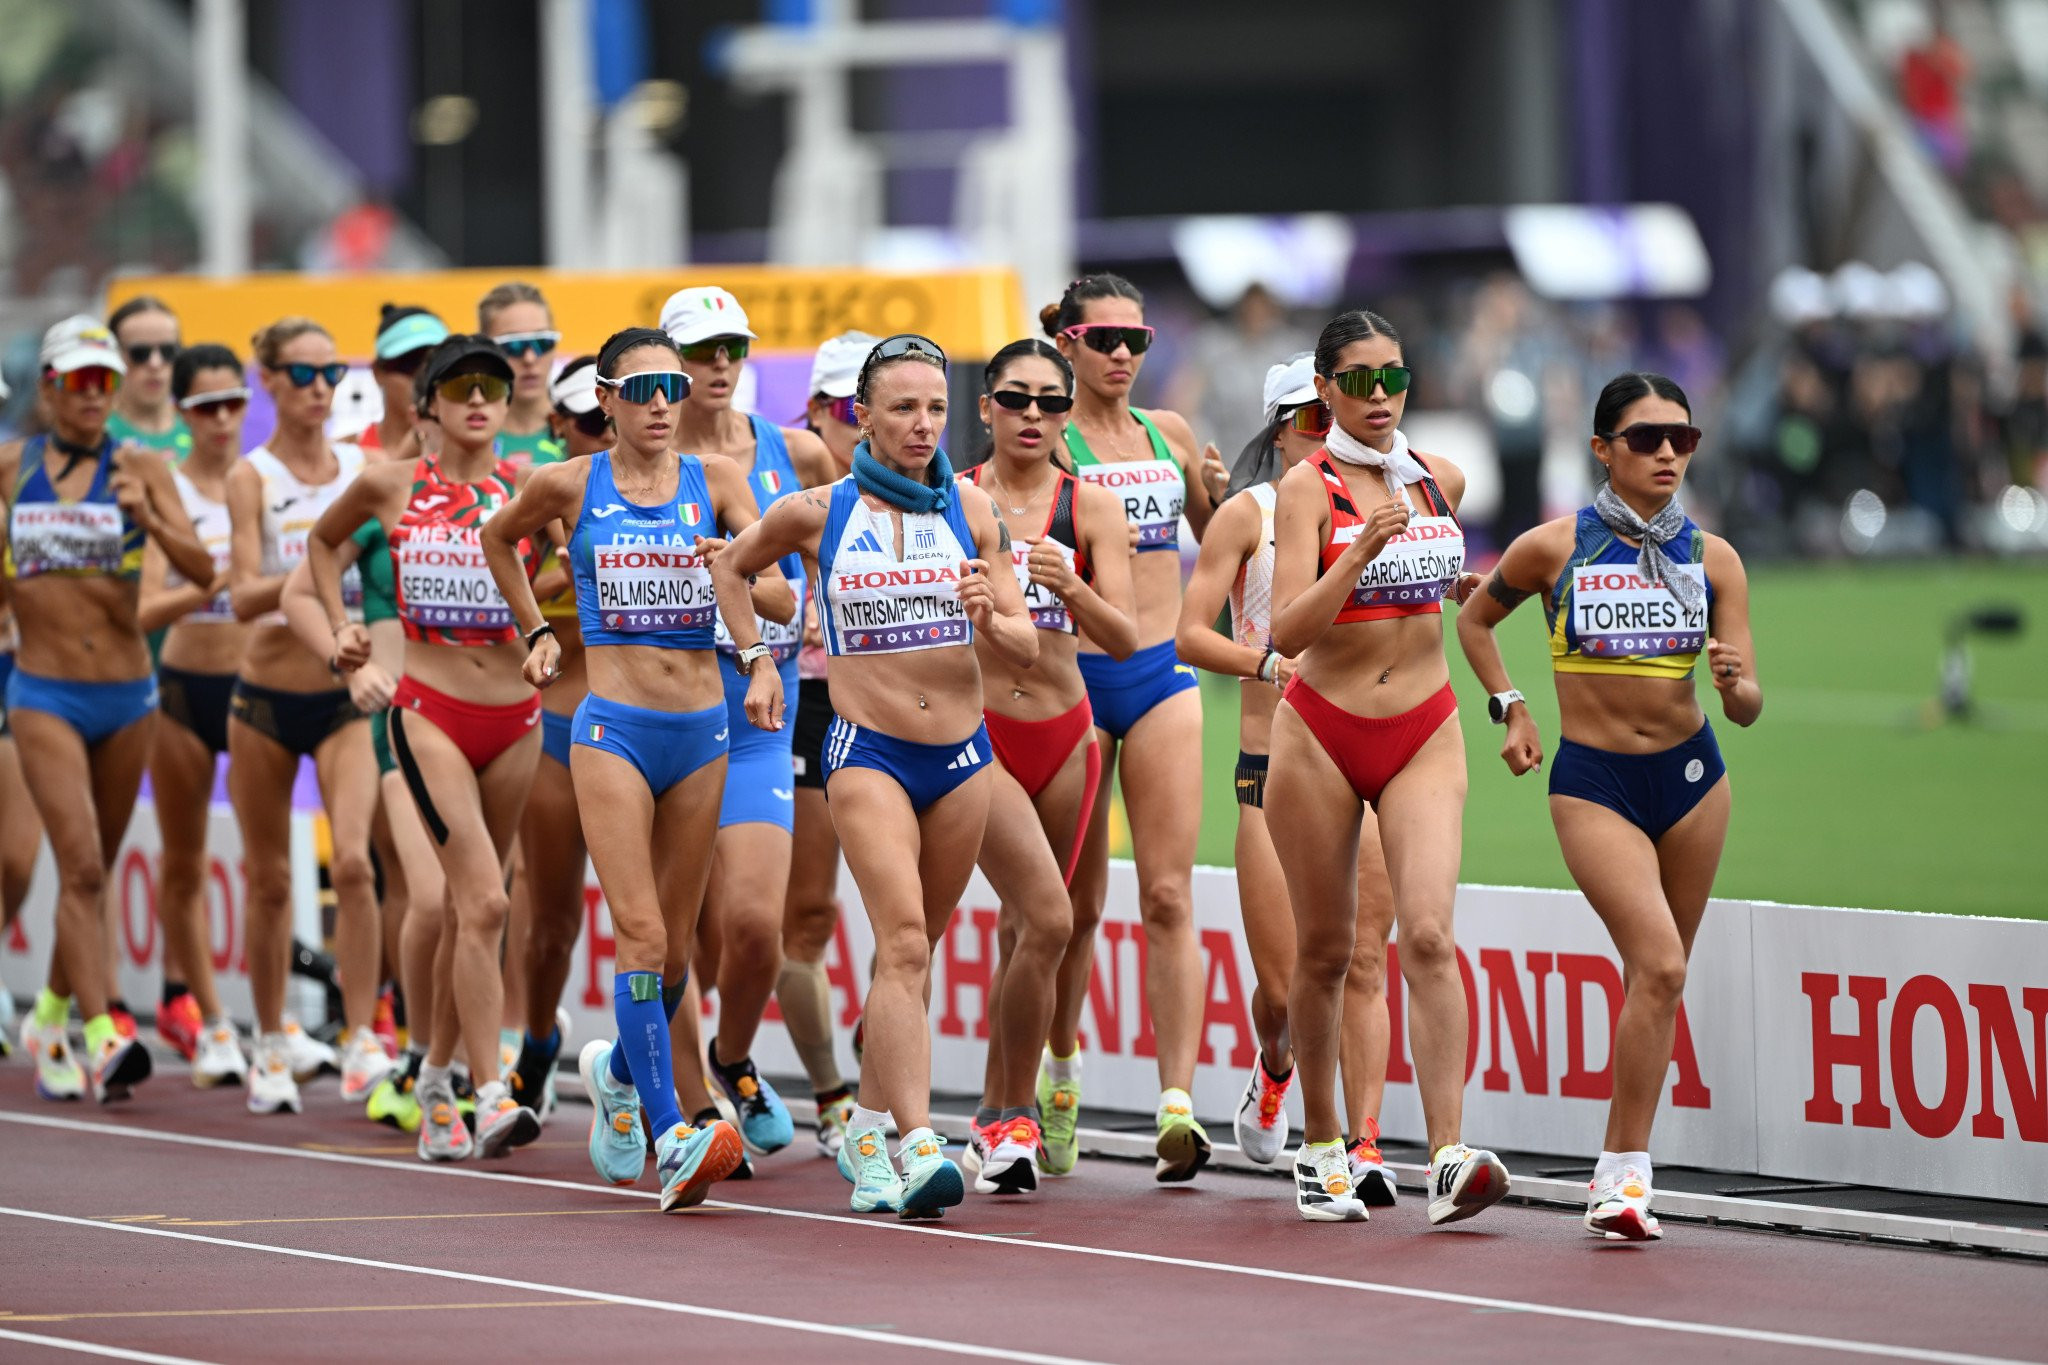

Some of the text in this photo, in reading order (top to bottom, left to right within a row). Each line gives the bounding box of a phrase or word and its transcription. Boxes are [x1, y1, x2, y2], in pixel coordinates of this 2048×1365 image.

[1083, 468, 1178, 487] HONDA
[1124, 495, 1163, 520] RA
[408, 520, 482, 545] MÉXI
[621, 518, 676, 528] FRECCIAROSSA
[403, 550, 489, 569] HOND
[906, 552, 944, 562] AEGEAN
[1360, 553, 1412, 587] GARCÍA
[1412, 550, 1447, 581] LEÓN
[403, 576, 488, 603] SERRANO
[838, 567, 961, 592] HONDA
[1577, 573, 1667, 592] HON
[600, 580, 715, 606] PALMISANO 145
[841, 595, 964, 627] NTRISMPIOTI 134
[1579, 601, 1704, 631] TORRES 121
[937, 906, 1259, 1072] HNA
[646, 1022, 661, 1090] Palmisano
